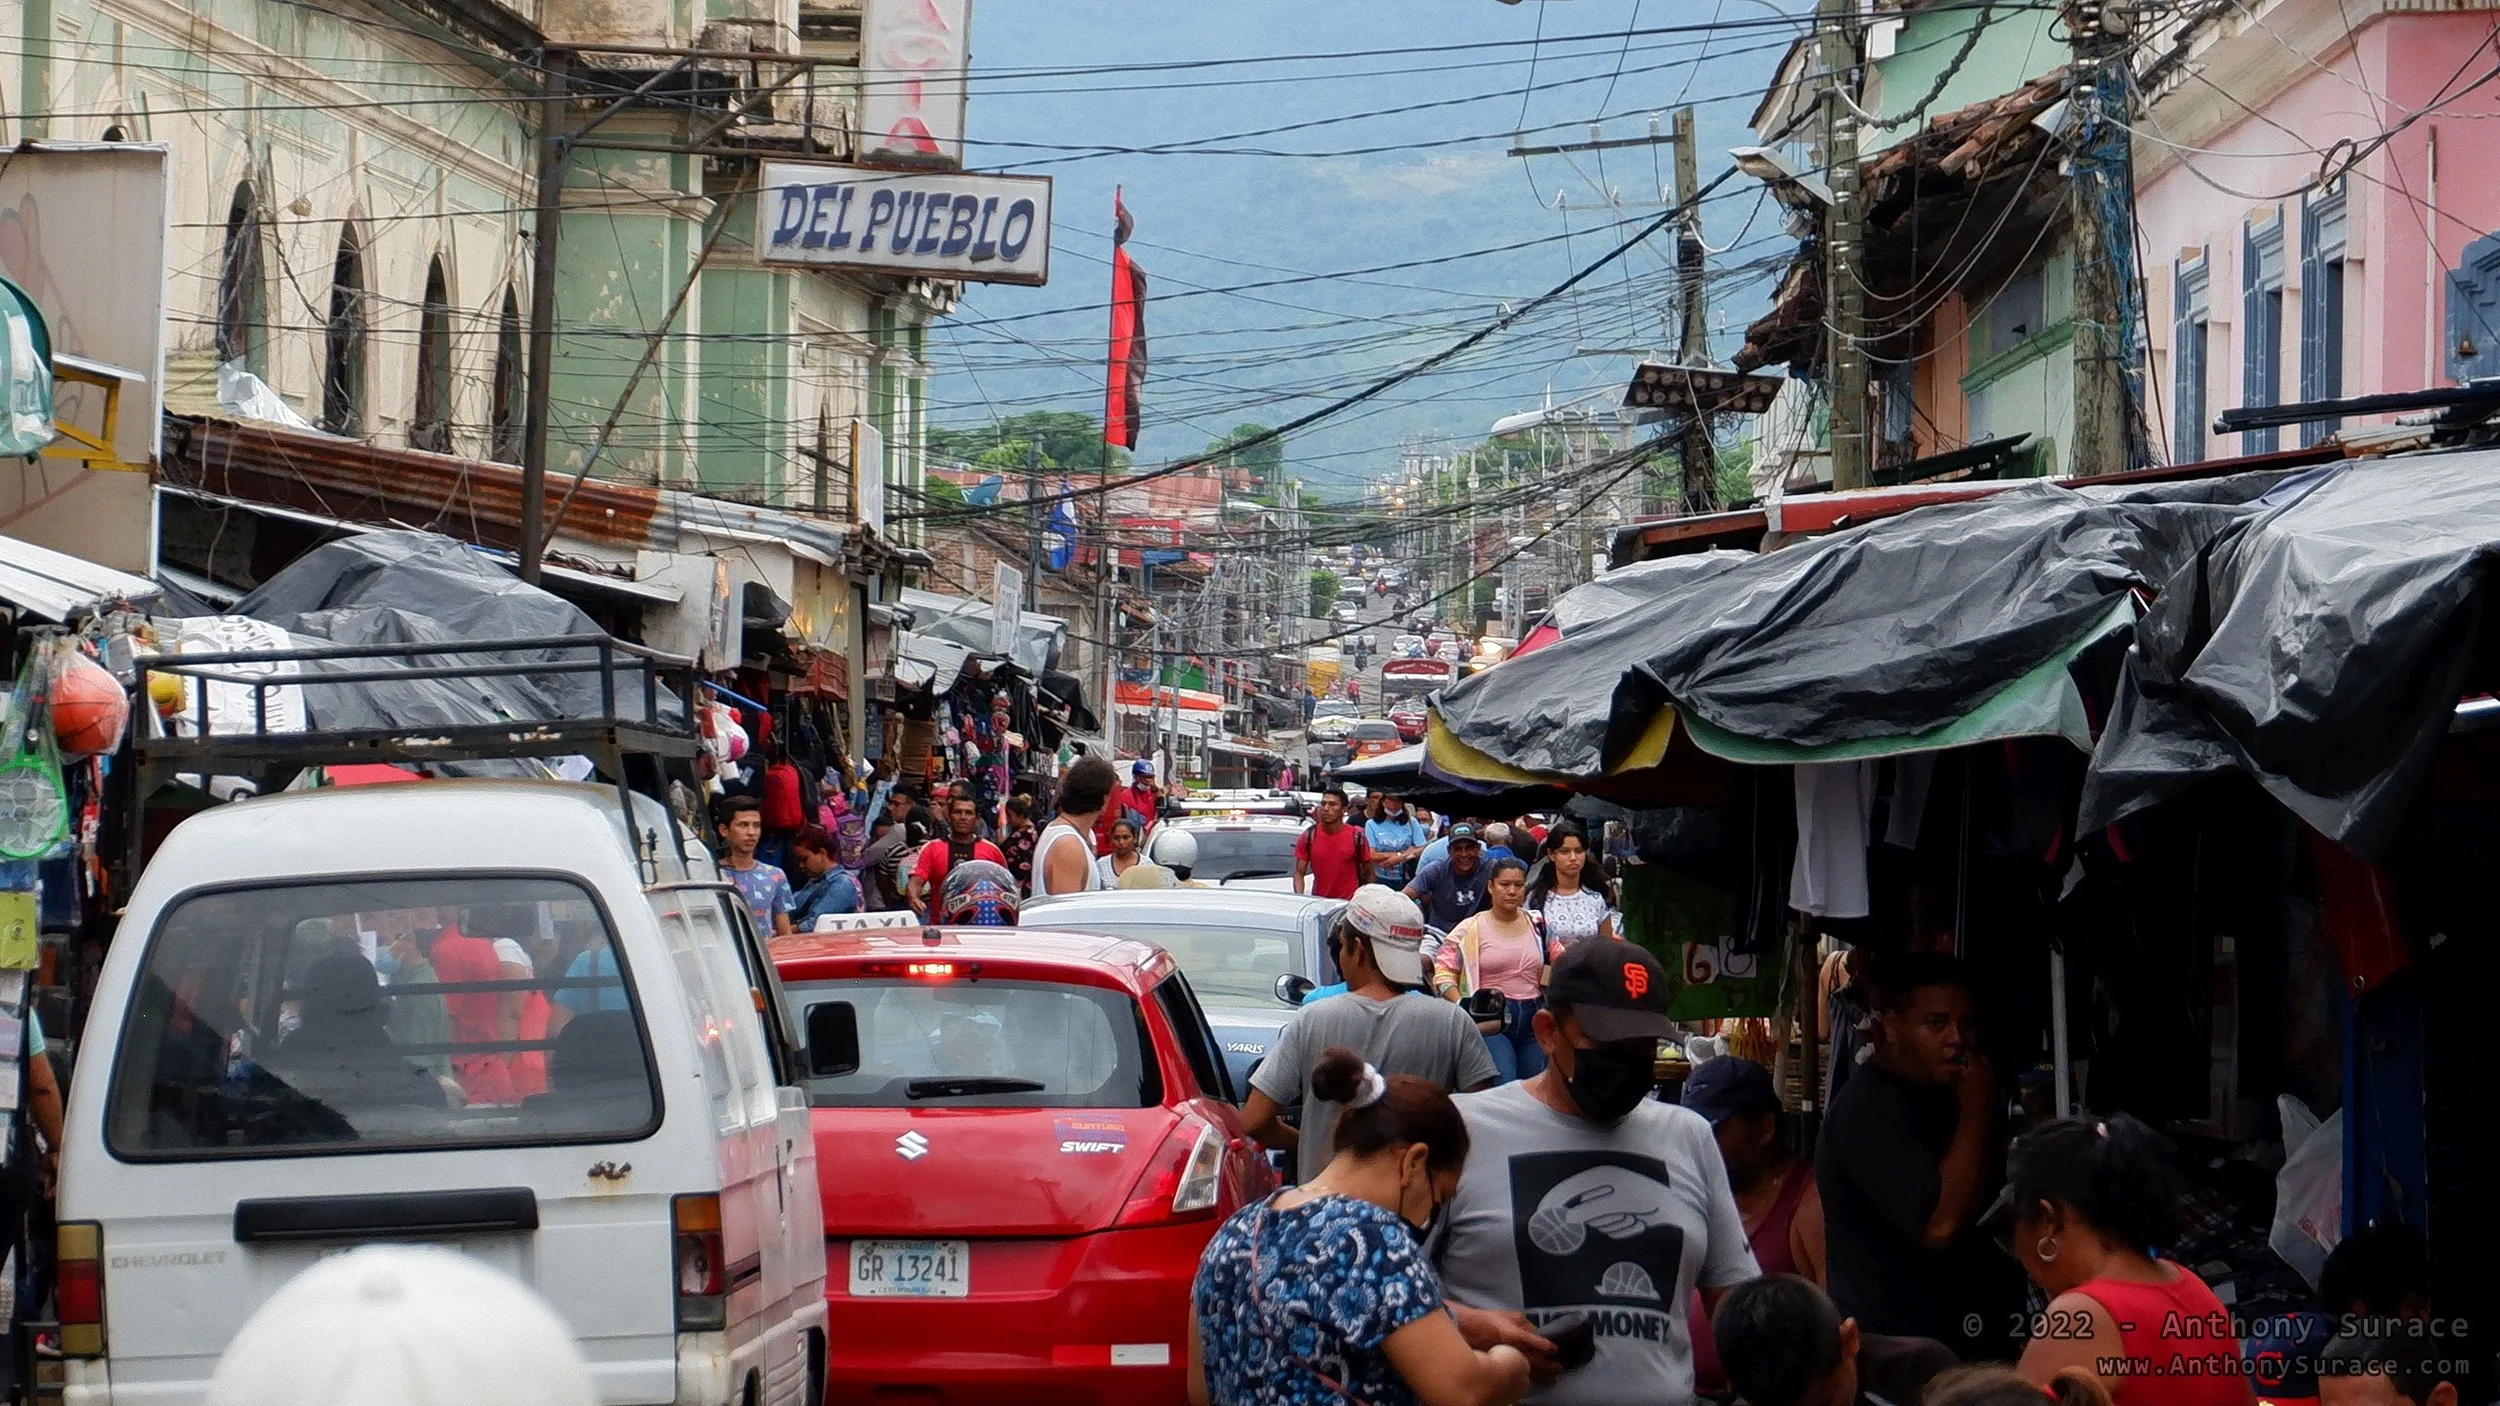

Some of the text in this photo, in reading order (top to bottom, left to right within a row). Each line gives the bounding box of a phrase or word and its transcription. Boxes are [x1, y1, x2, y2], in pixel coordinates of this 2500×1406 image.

[771, 184, 1035, 262] DEL PUEBLO
[830, 916, 907, 931] TAXI
[1226, 1042, 1265, 1054] YARIS
[1060, 1141, 1124, 1154] SWIFT
[111, 1250, 226, 1269] CHEVROLET
[858, 1255, 959, 1282] GR 13241
[1588, 1310, 1671, 1344] MONEY
